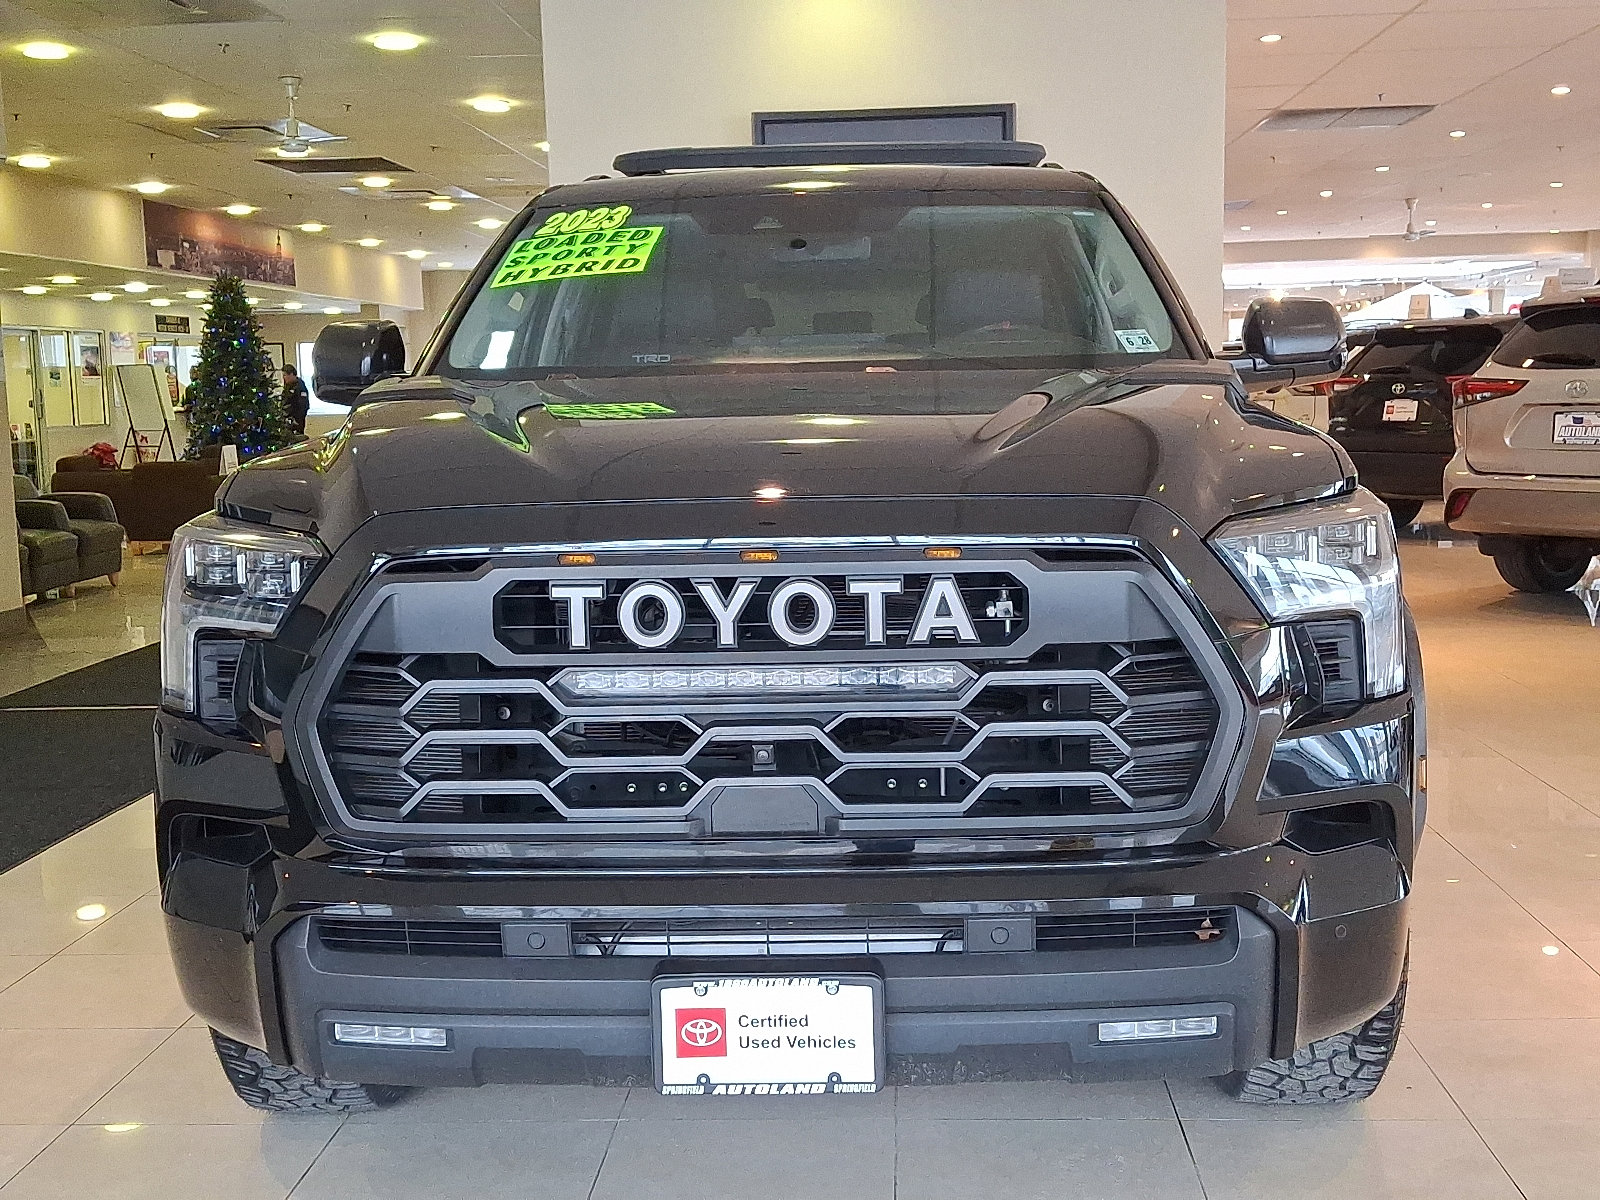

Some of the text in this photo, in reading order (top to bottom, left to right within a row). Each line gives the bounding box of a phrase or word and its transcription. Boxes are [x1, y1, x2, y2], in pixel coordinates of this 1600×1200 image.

[534, 205, 633, 238] 2023
[513, 229, 655, 254] LOADED
[504, 243, 650, 269] SPORTY
[497, 257, 642, 285] HYBRID
[1126, 336, 1135, 346] 6
[631, 354, 671, 364] TRD
[1558, 425, 1600, 437] AUTOLAN
[548, 573, 982, 650] TOYOTA
[738, 1014, 809, 1028] Certified
[739, 1035, 857, 1049] Used Vehicles
[711, 1083, 827, 1096] AUTOLAND
